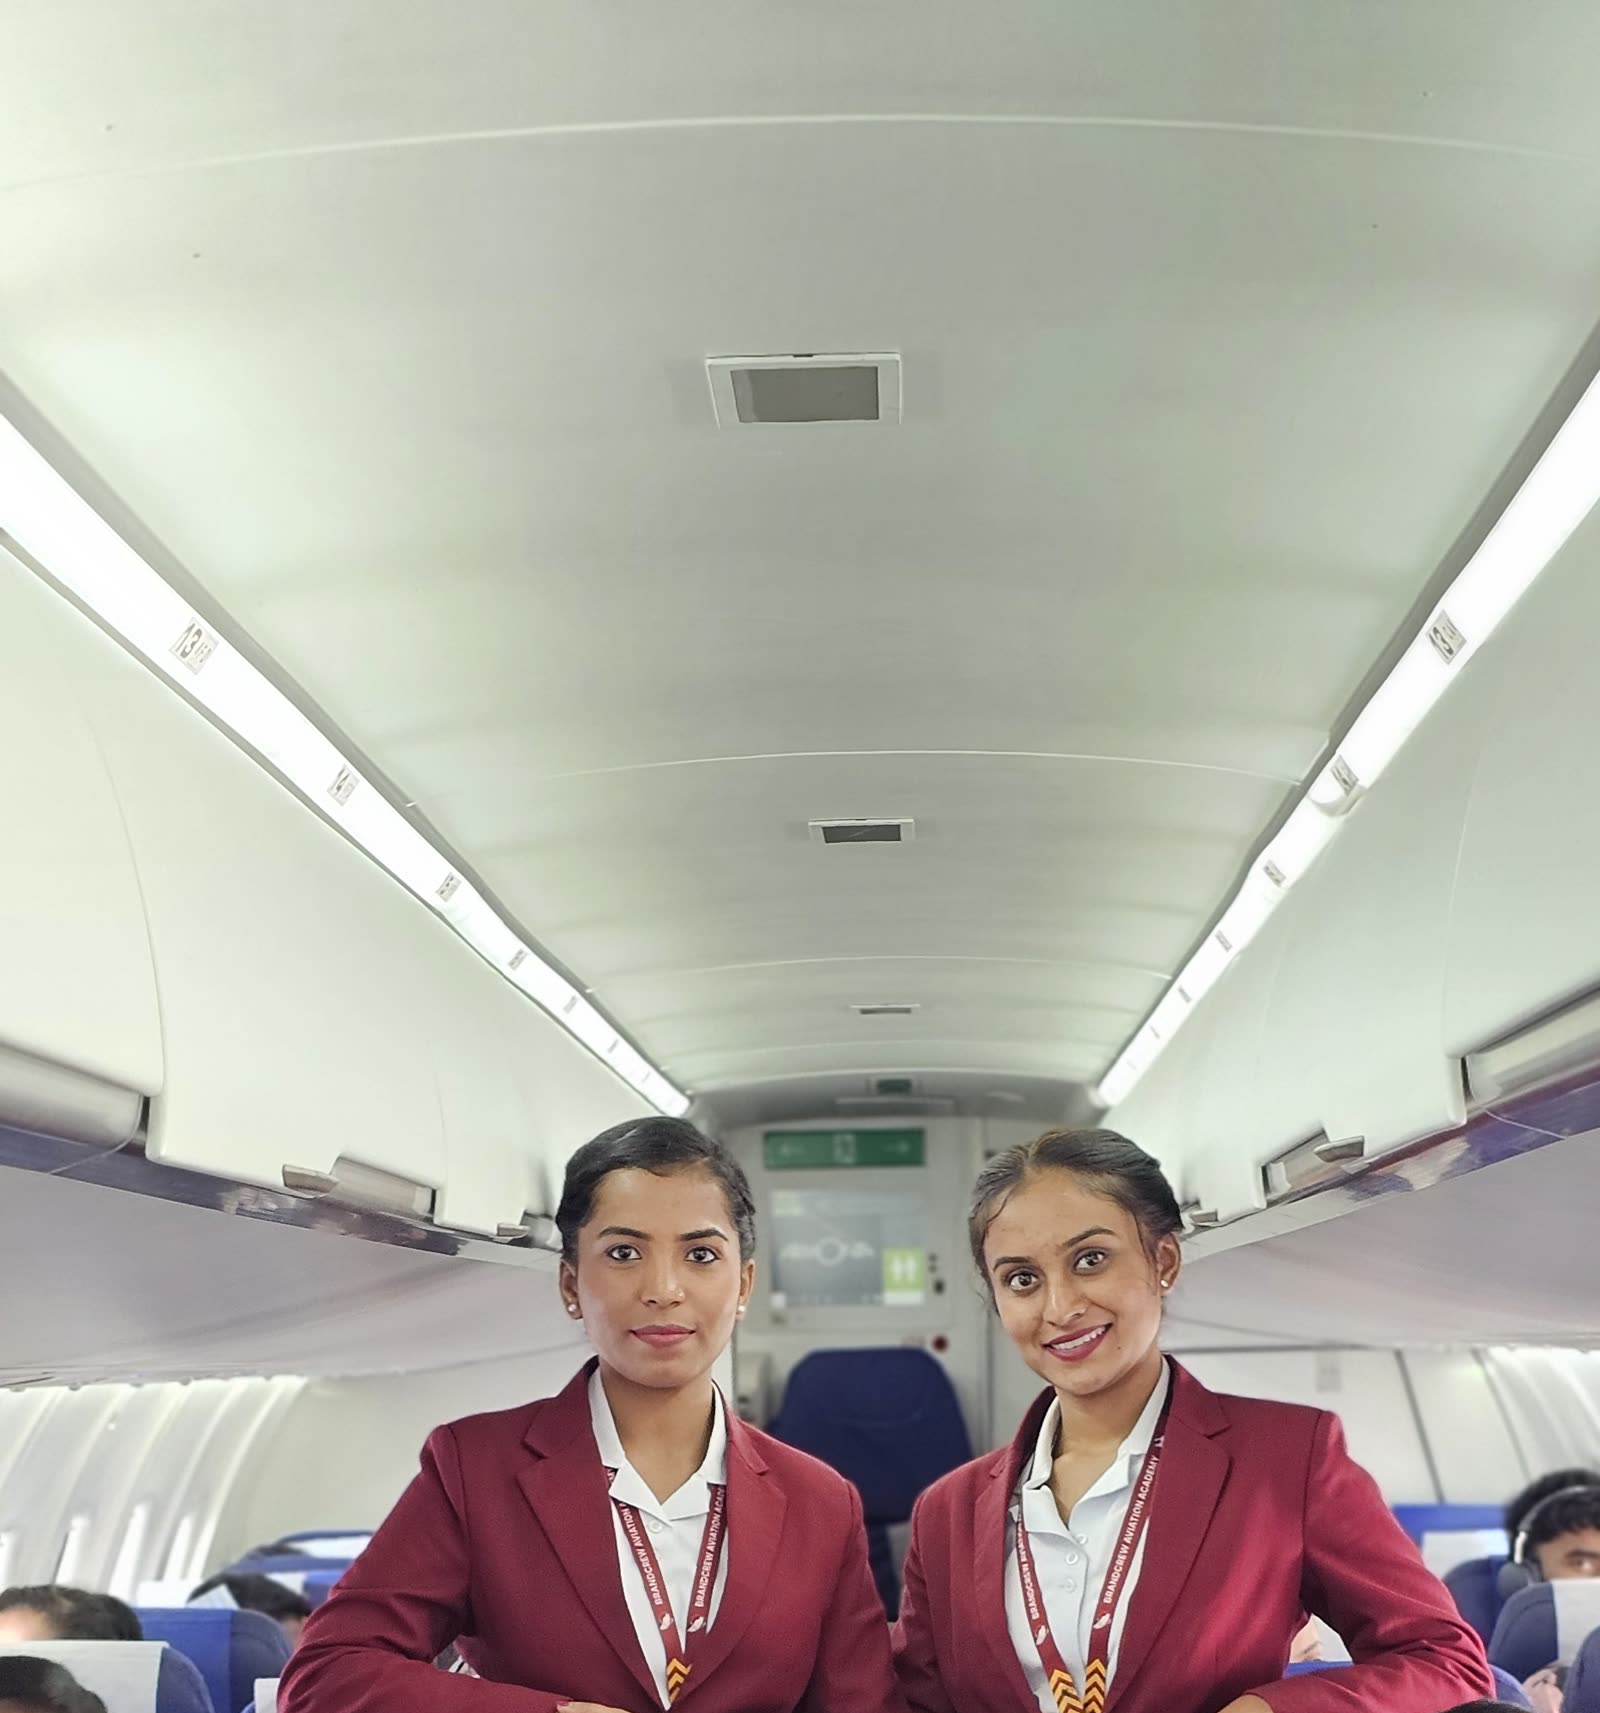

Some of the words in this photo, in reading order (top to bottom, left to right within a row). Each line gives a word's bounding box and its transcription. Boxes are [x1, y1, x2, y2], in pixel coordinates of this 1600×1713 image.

[175, 623, 203, 659] 13
[621, 1508, 643, 1547] AVIATION
[1104, 1544, 1129, 1604] BRANDCREW
[1123, 1500, 1145, 1545] AVIATION
[1137, 1455, 1159, 1501] ACADEMY
[635, 1547, 663, 1605] BRANDCREW
[695, 1552, 714, 1607] BRANDCREW
[706, 1513, 721, 1553] AVIATION
[1022, 1563, 1040, 1620] BRANDCREW
